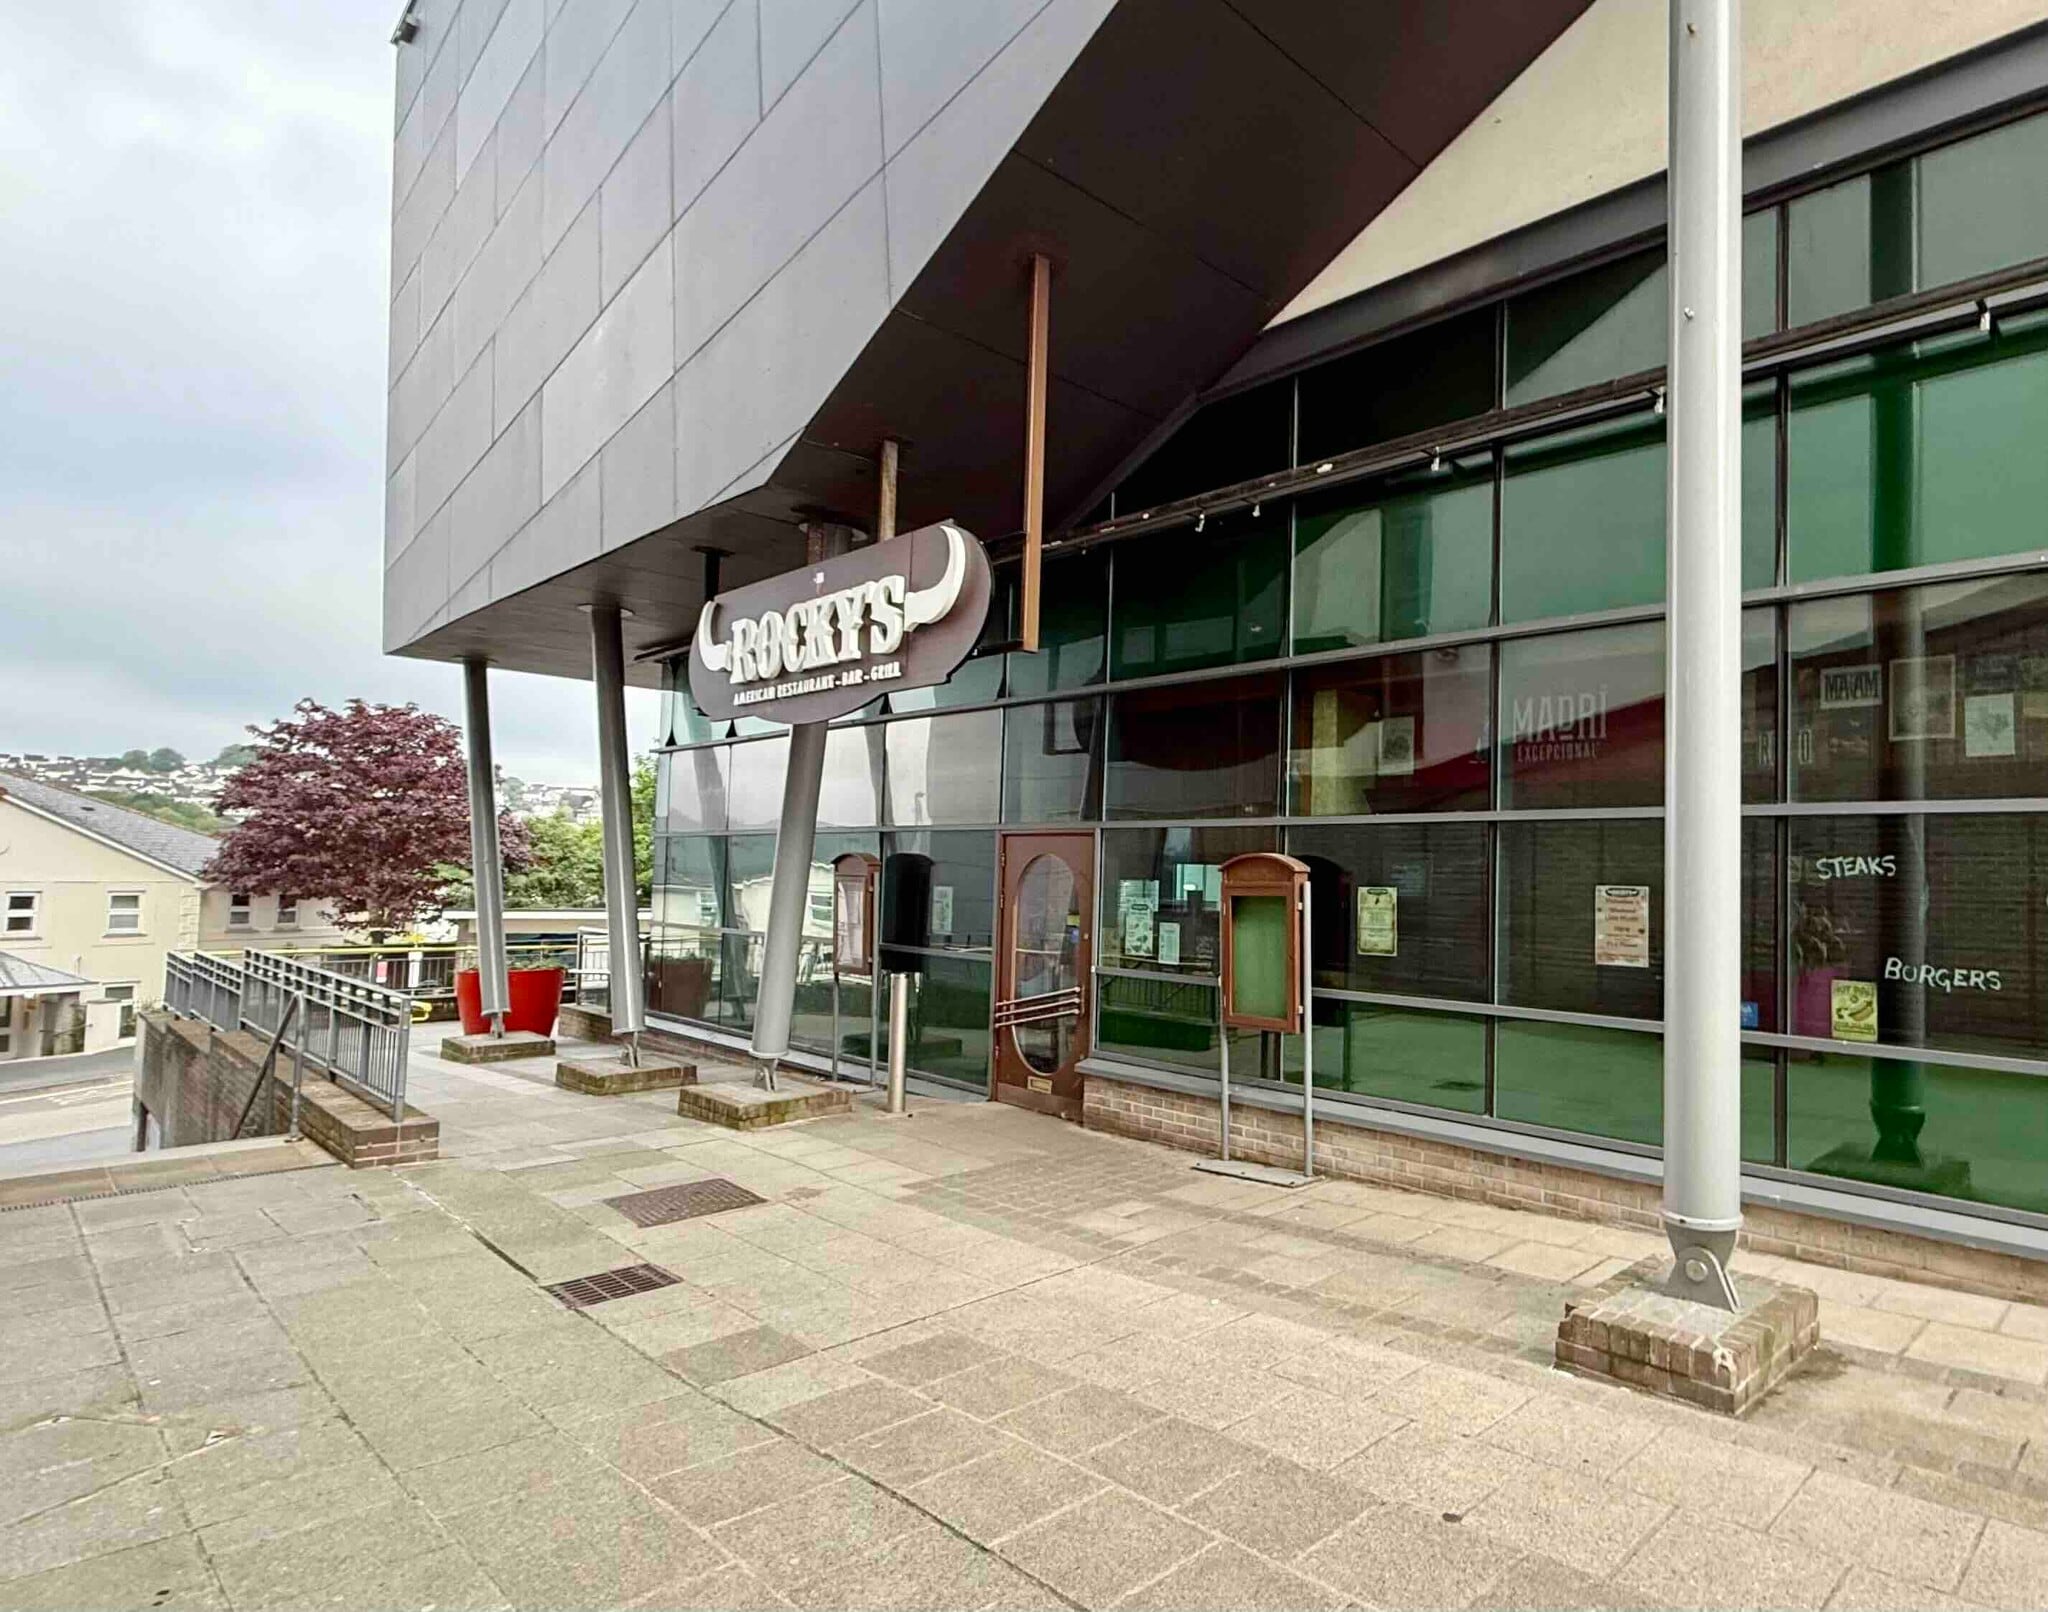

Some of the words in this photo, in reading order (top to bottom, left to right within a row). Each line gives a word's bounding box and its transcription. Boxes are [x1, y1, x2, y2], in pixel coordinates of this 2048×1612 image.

[730, 574, 905, 684] ROCKY'S
[733, 686, 776, 706] AMERICAN
[776, 674, 836, 699] RESTAURANT
[841, 669, 864, 686] BAR
[870, 661, 902, 681] GRILL
[1816, 855, 1897, 880] STEAKS
[1884, 957, 2002, 992] BURGERS
